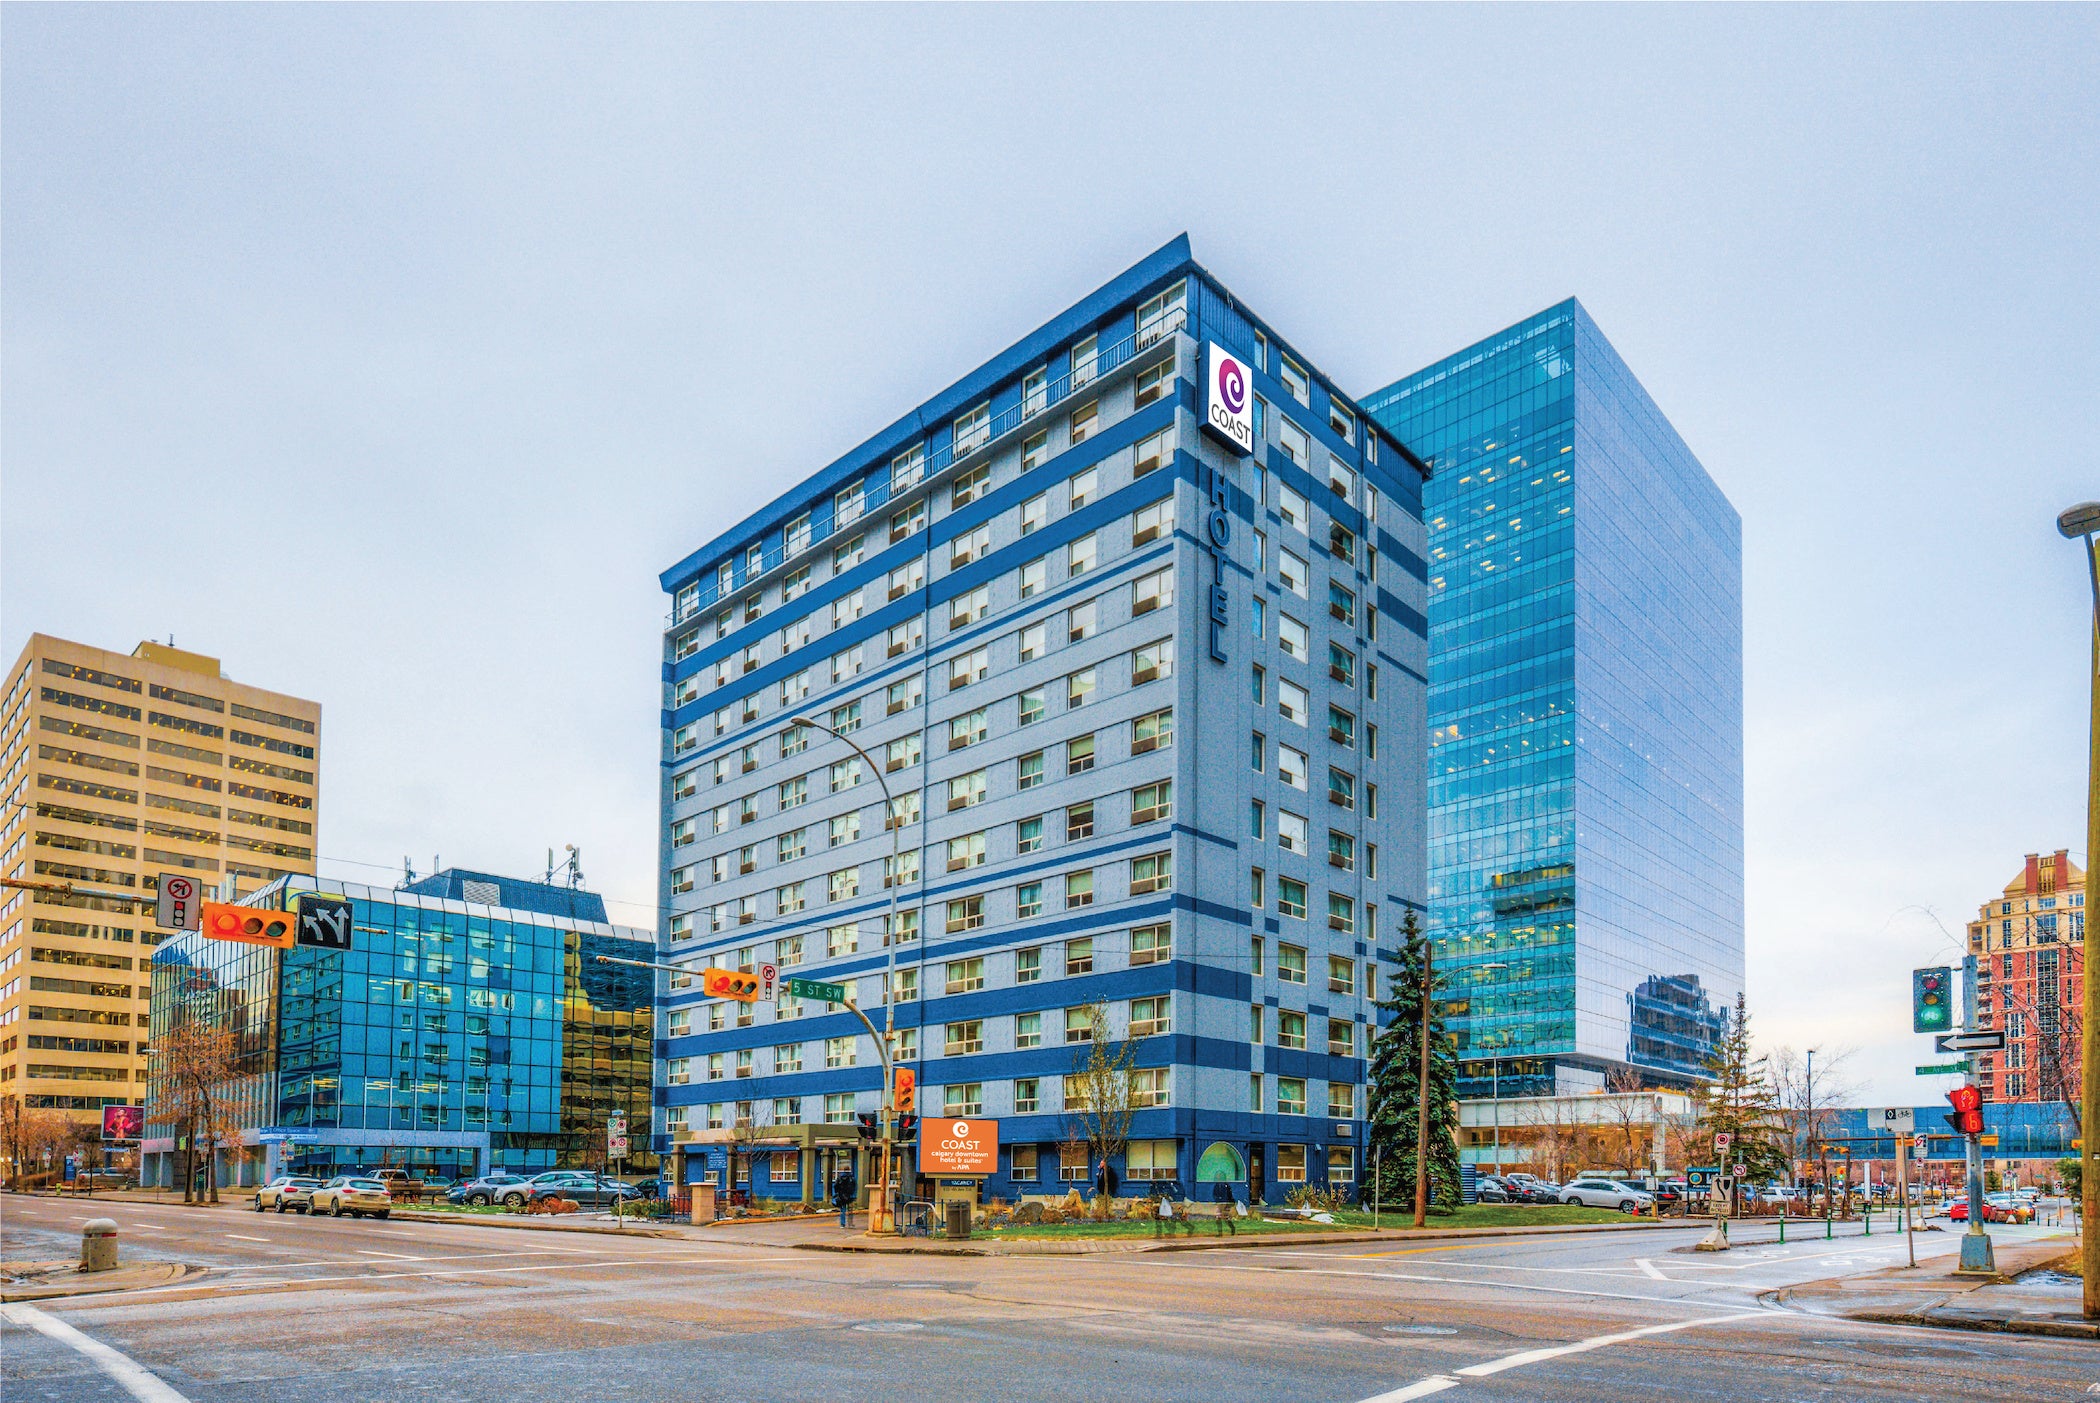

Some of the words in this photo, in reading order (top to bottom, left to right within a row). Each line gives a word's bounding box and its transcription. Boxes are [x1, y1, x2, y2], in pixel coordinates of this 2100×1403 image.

[1211, 403, 1251, 444] COAST
[1208, 466, 1231, 665] HOTEL
[794, 982, 801, 993] 5
[807, 984, 820, 996] ST
[826, 987, 842, 999] SW
[941, 1140, 981, 1150] COAST
[931, 1150, 954, 1158] calgary
